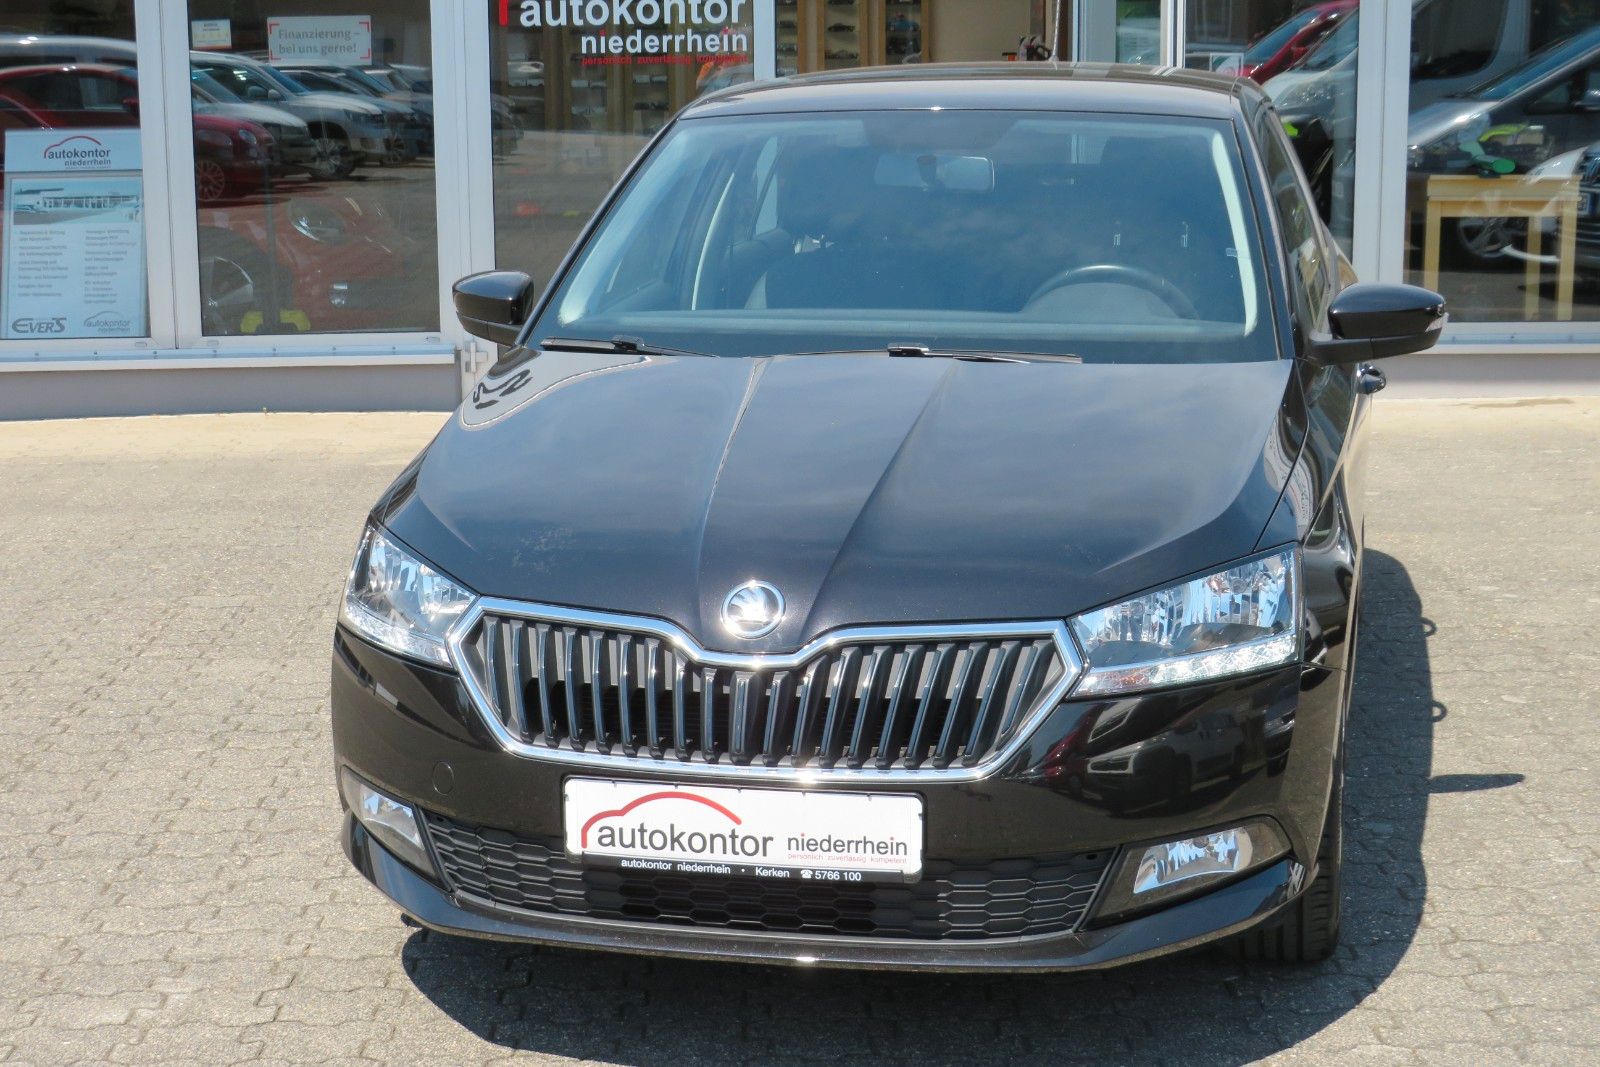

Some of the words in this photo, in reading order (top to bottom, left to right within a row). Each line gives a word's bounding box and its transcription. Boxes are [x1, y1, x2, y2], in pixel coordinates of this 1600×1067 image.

[519, 0, 746, 27] autokontor
[278, 28, 351, 42] Finanzierung
[581, 27, 748, 55] niederrhein
[278, 44, 296, 54] bei
[299, 44, 318, 54] uns
[320, 43, 357, 57] gerne!
[48, 148, 111, 160] autokontor
[64, 159, 112, 168] niederrhein
[87, 319, 130, 328] autokontor
[597, 822, 774, 858] autokontor
[787, 833, 908, 856] niederrhein
[621, 858, 672, 871] autokontor
[677, 862, 731, 874] niederrhein
[755, 867, 790, 878] Kerken
[815, 870, 840, 880] 5766
[843, 871, 862, 881] 100
